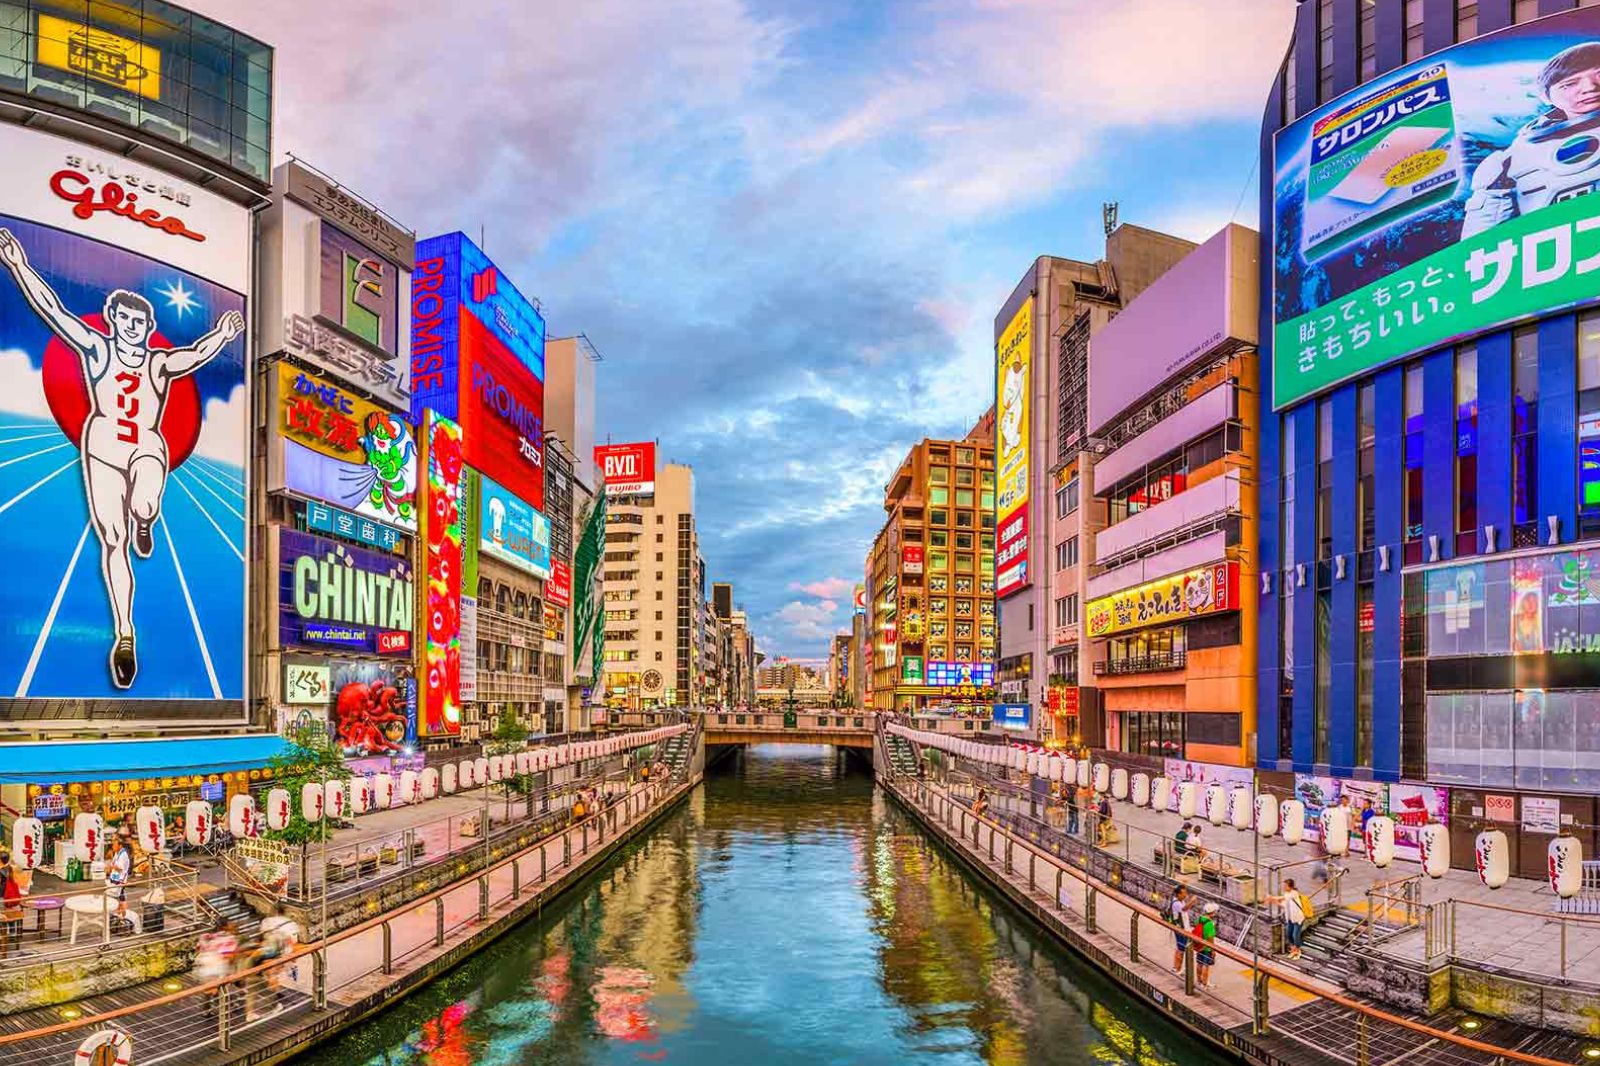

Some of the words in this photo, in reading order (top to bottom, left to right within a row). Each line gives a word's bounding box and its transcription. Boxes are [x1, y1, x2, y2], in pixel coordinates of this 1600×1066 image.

[1318, 86, 1441, 157] サロンパス
[50, 170, 206, 242] Glico
[411, 256, 445, 393] PROMISE
[1297, 297, 1456, 373] きもちいい。
[114, 371, 142, 444] グリコ
[294, 373, 354, 415] かぜに
[472, 362, 542, 448] PROMISE
[295, 548, 413, 632] CHINTAI
[296, 670, 322, 698] くくる
